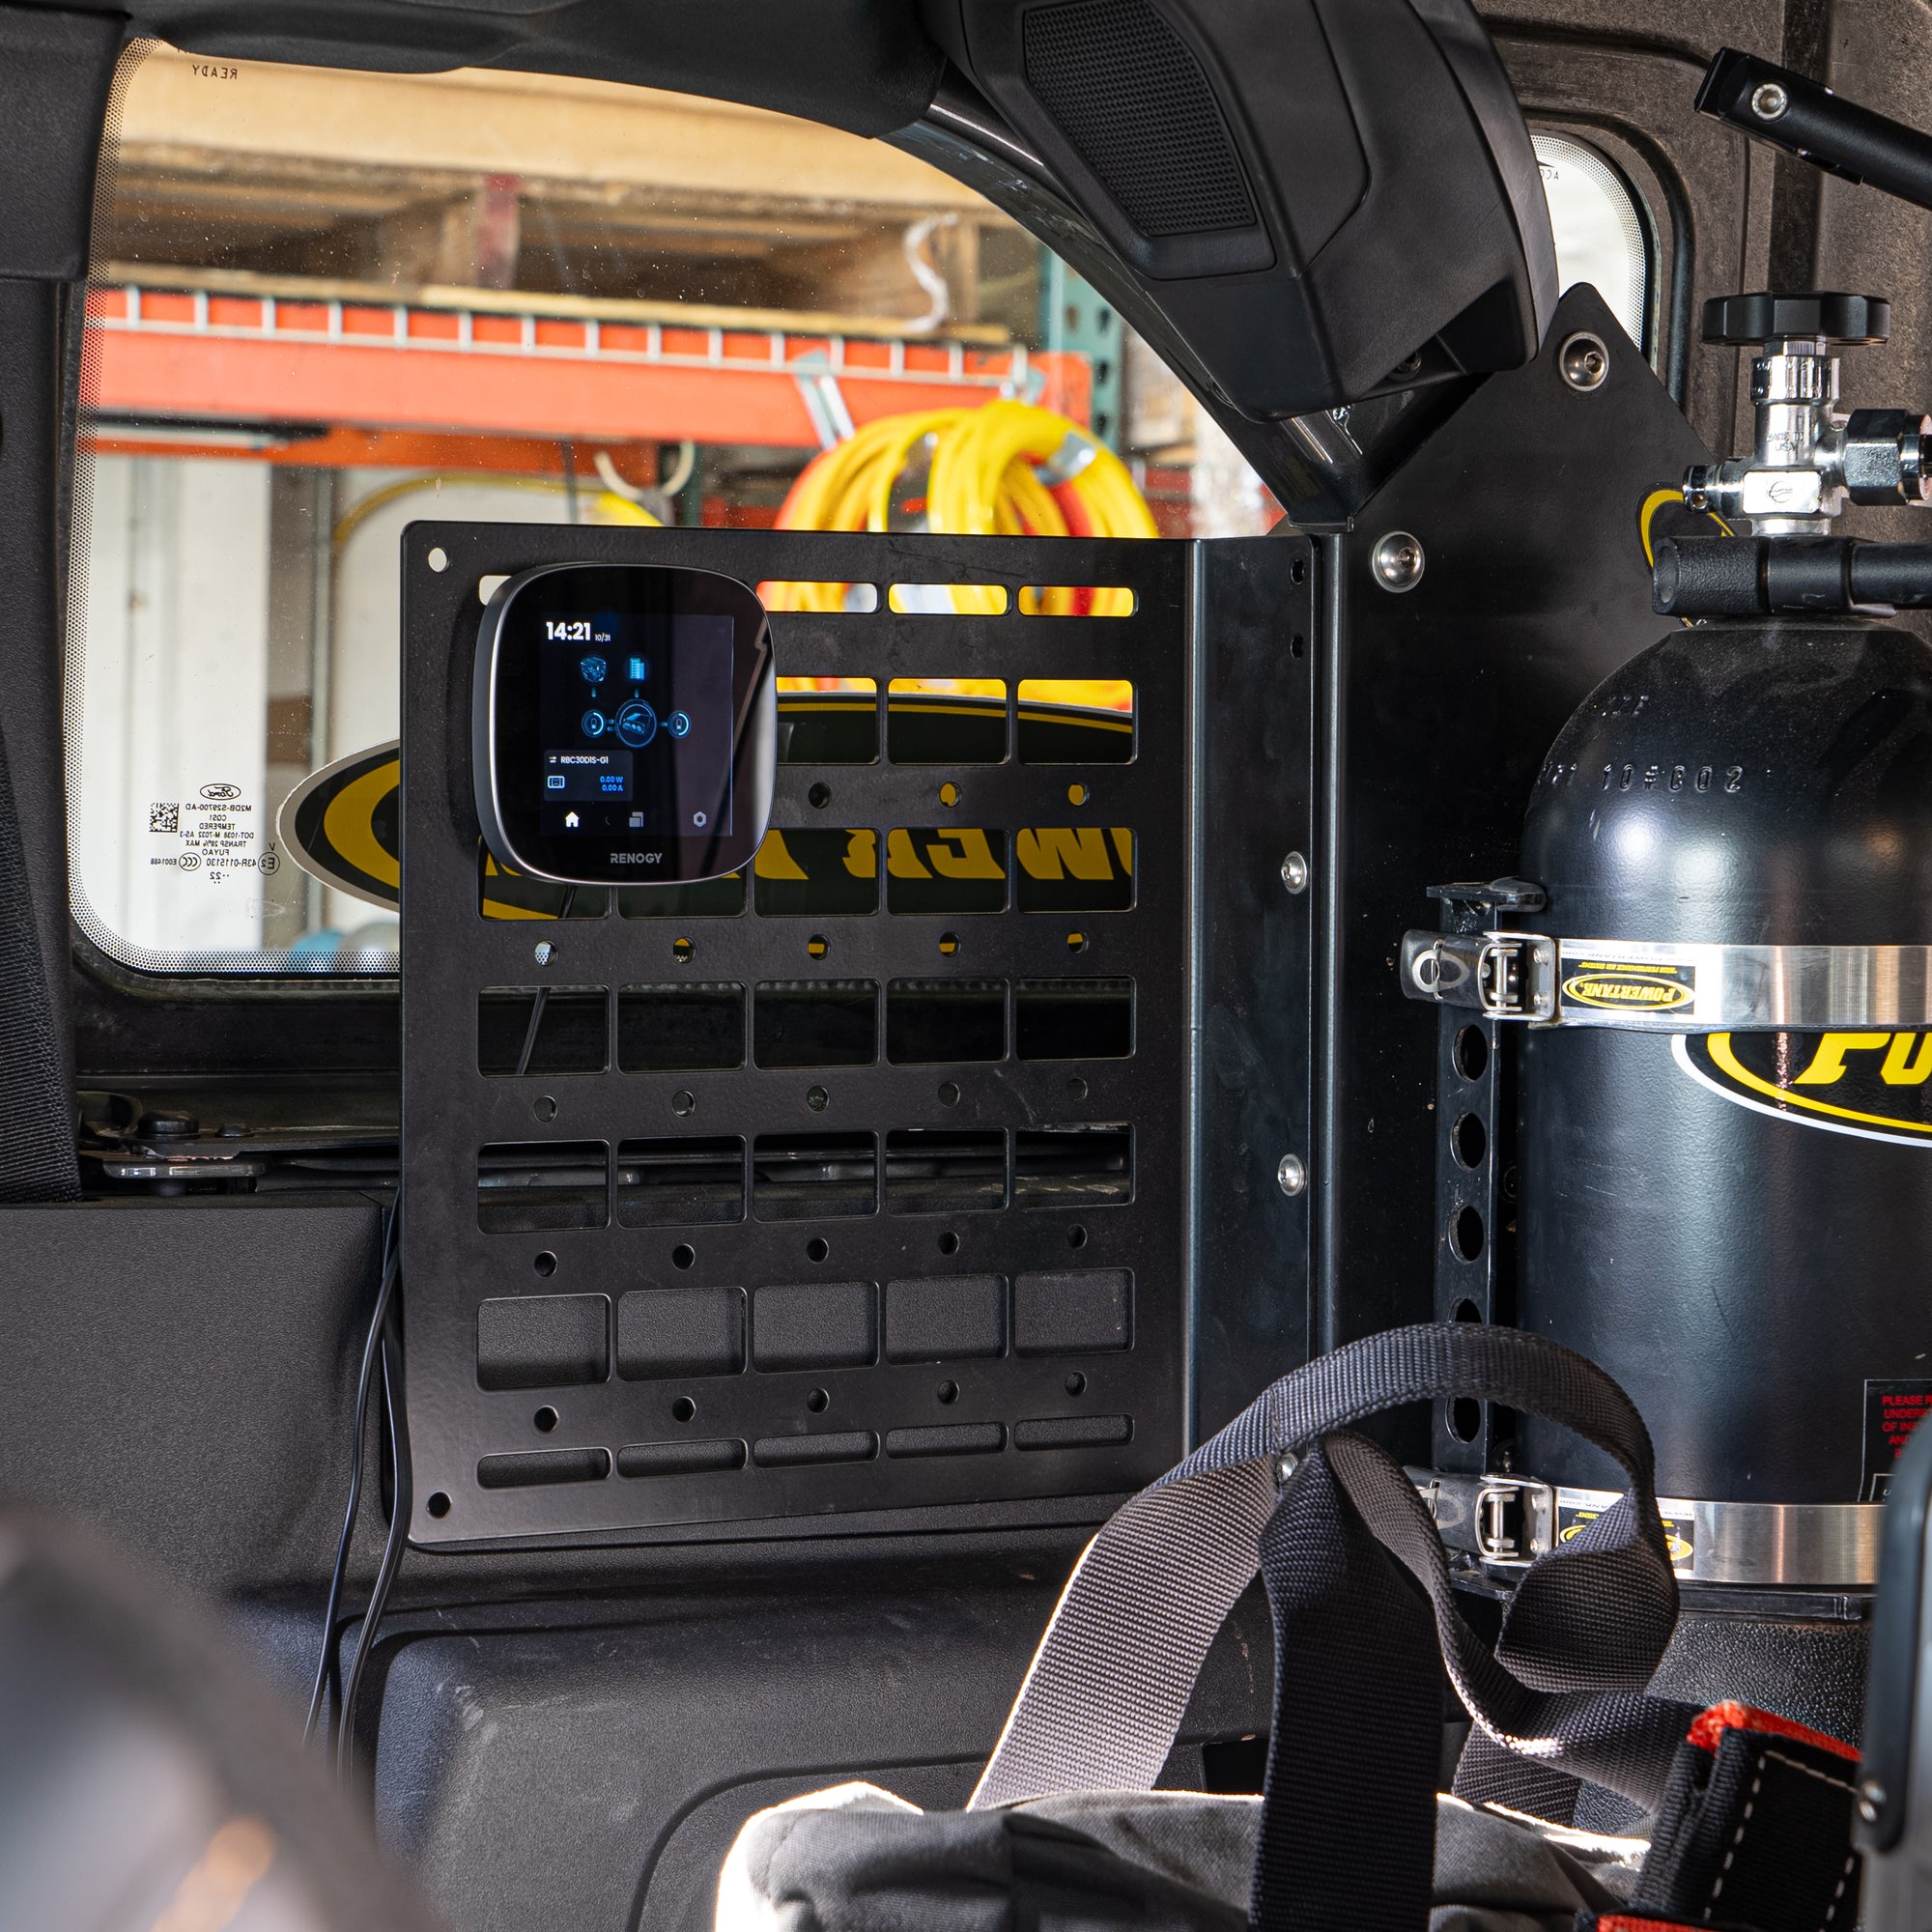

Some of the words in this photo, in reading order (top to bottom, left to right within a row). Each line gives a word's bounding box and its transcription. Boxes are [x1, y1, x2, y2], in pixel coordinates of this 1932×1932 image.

[546, 621, 591, 641] 14:21
[610, 853, 664, 865] RENOGY
[1581, 982, 1676, 1002] POWERTANK
[1882, 1395, 1922, 1406] PLEASE
[1882, 1422, 1898, 1433] OF
